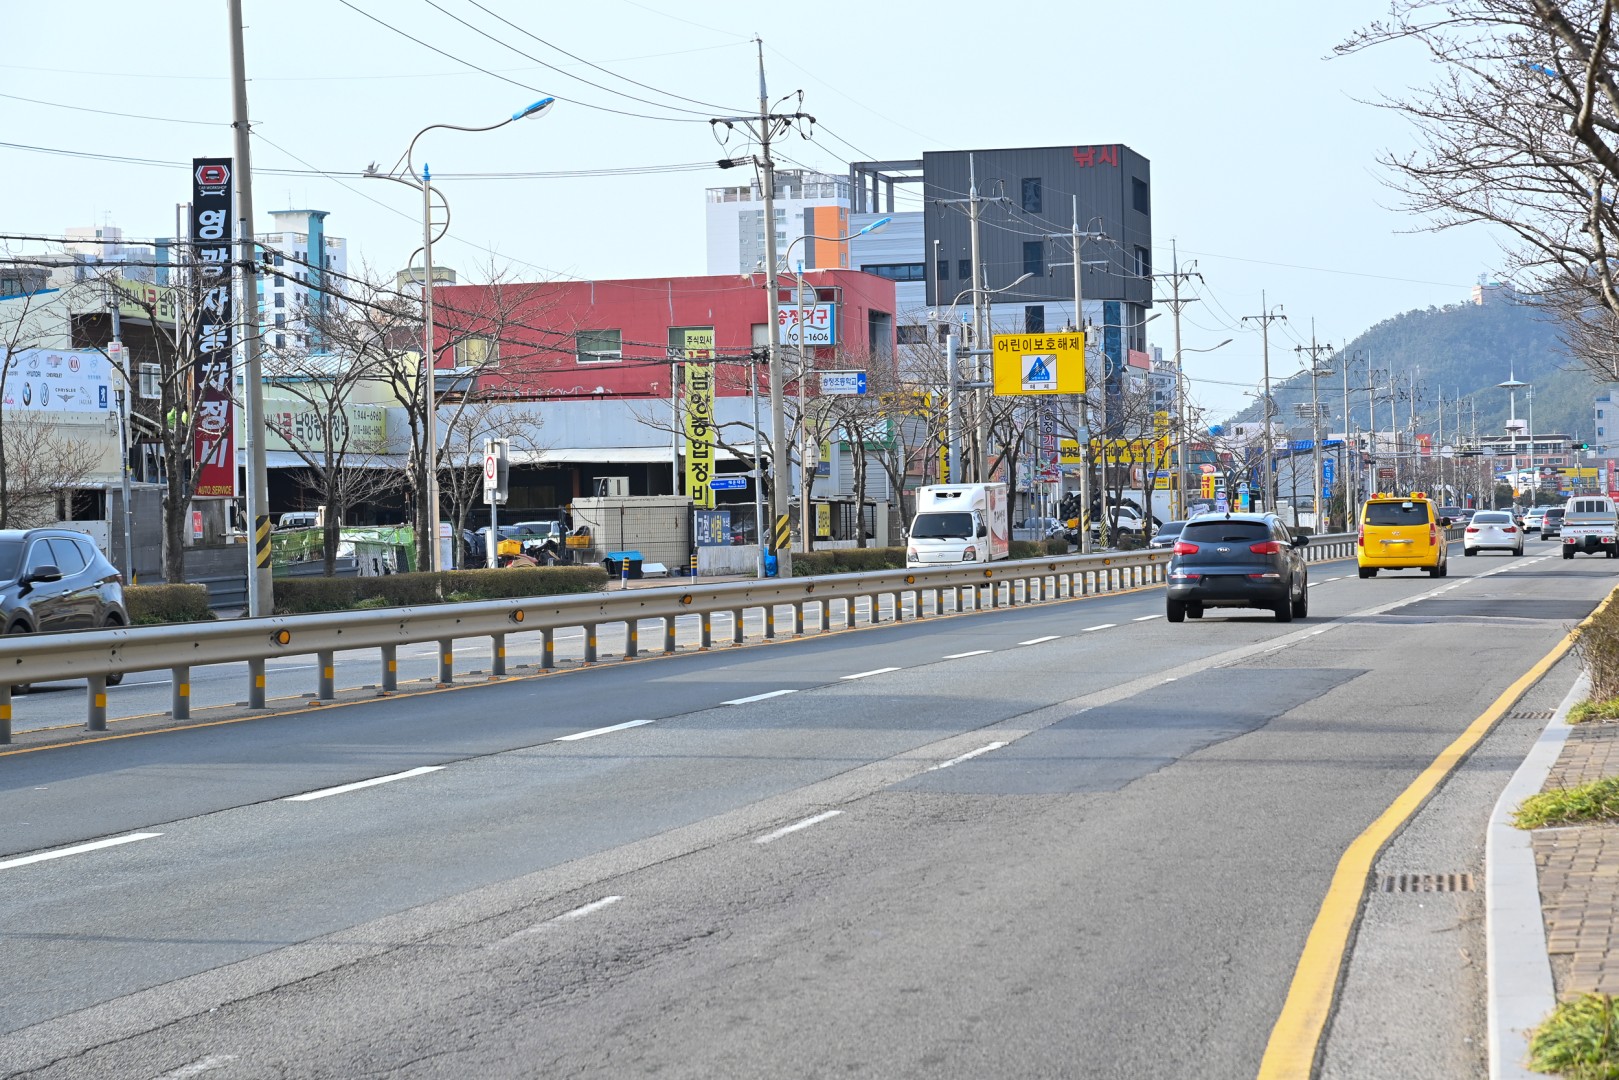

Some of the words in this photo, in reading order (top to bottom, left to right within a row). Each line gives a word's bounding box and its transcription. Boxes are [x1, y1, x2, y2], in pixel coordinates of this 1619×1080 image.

[1073, 145, 1118, 168] 낚시
[687, 335, 713, 345] 주식회사
[998, 337, 1079, 352] 어린이보호해제
[197, 485, 210, 495] AUTO
[212, 485, 233, 495] SERVICE
